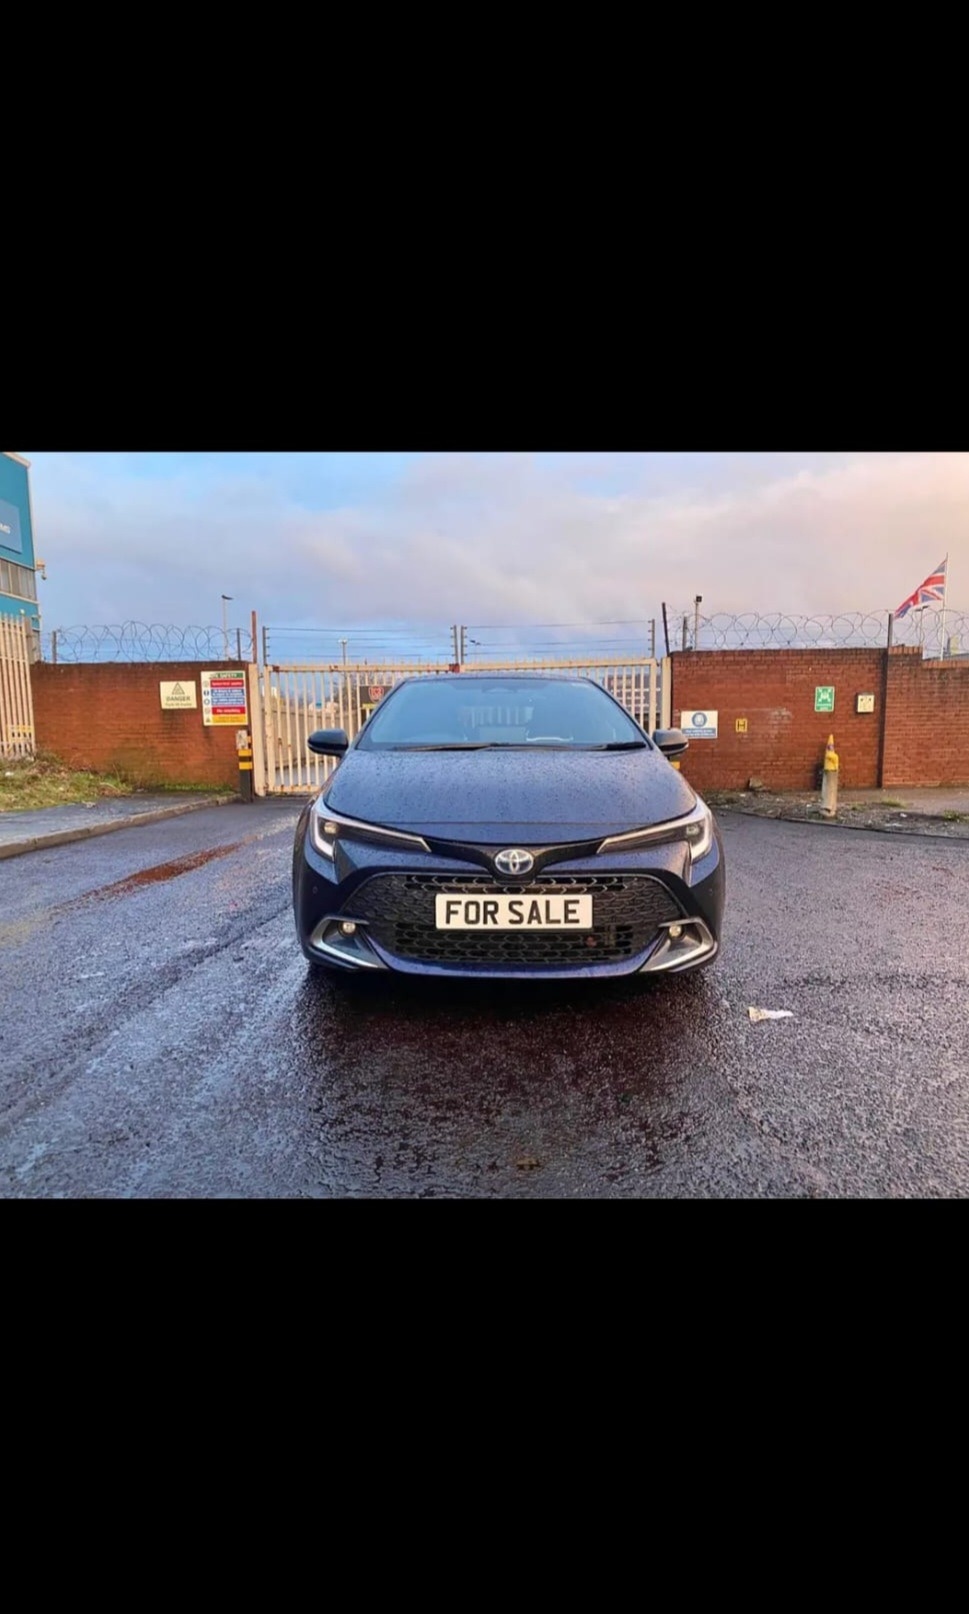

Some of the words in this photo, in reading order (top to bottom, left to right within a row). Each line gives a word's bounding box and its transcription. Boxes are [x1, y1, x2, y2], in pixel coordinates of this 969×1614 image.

[737, 720, 746, 730] H
[445, 900, 499, 925] FOR
[508, 899, 580, 925] SALE
